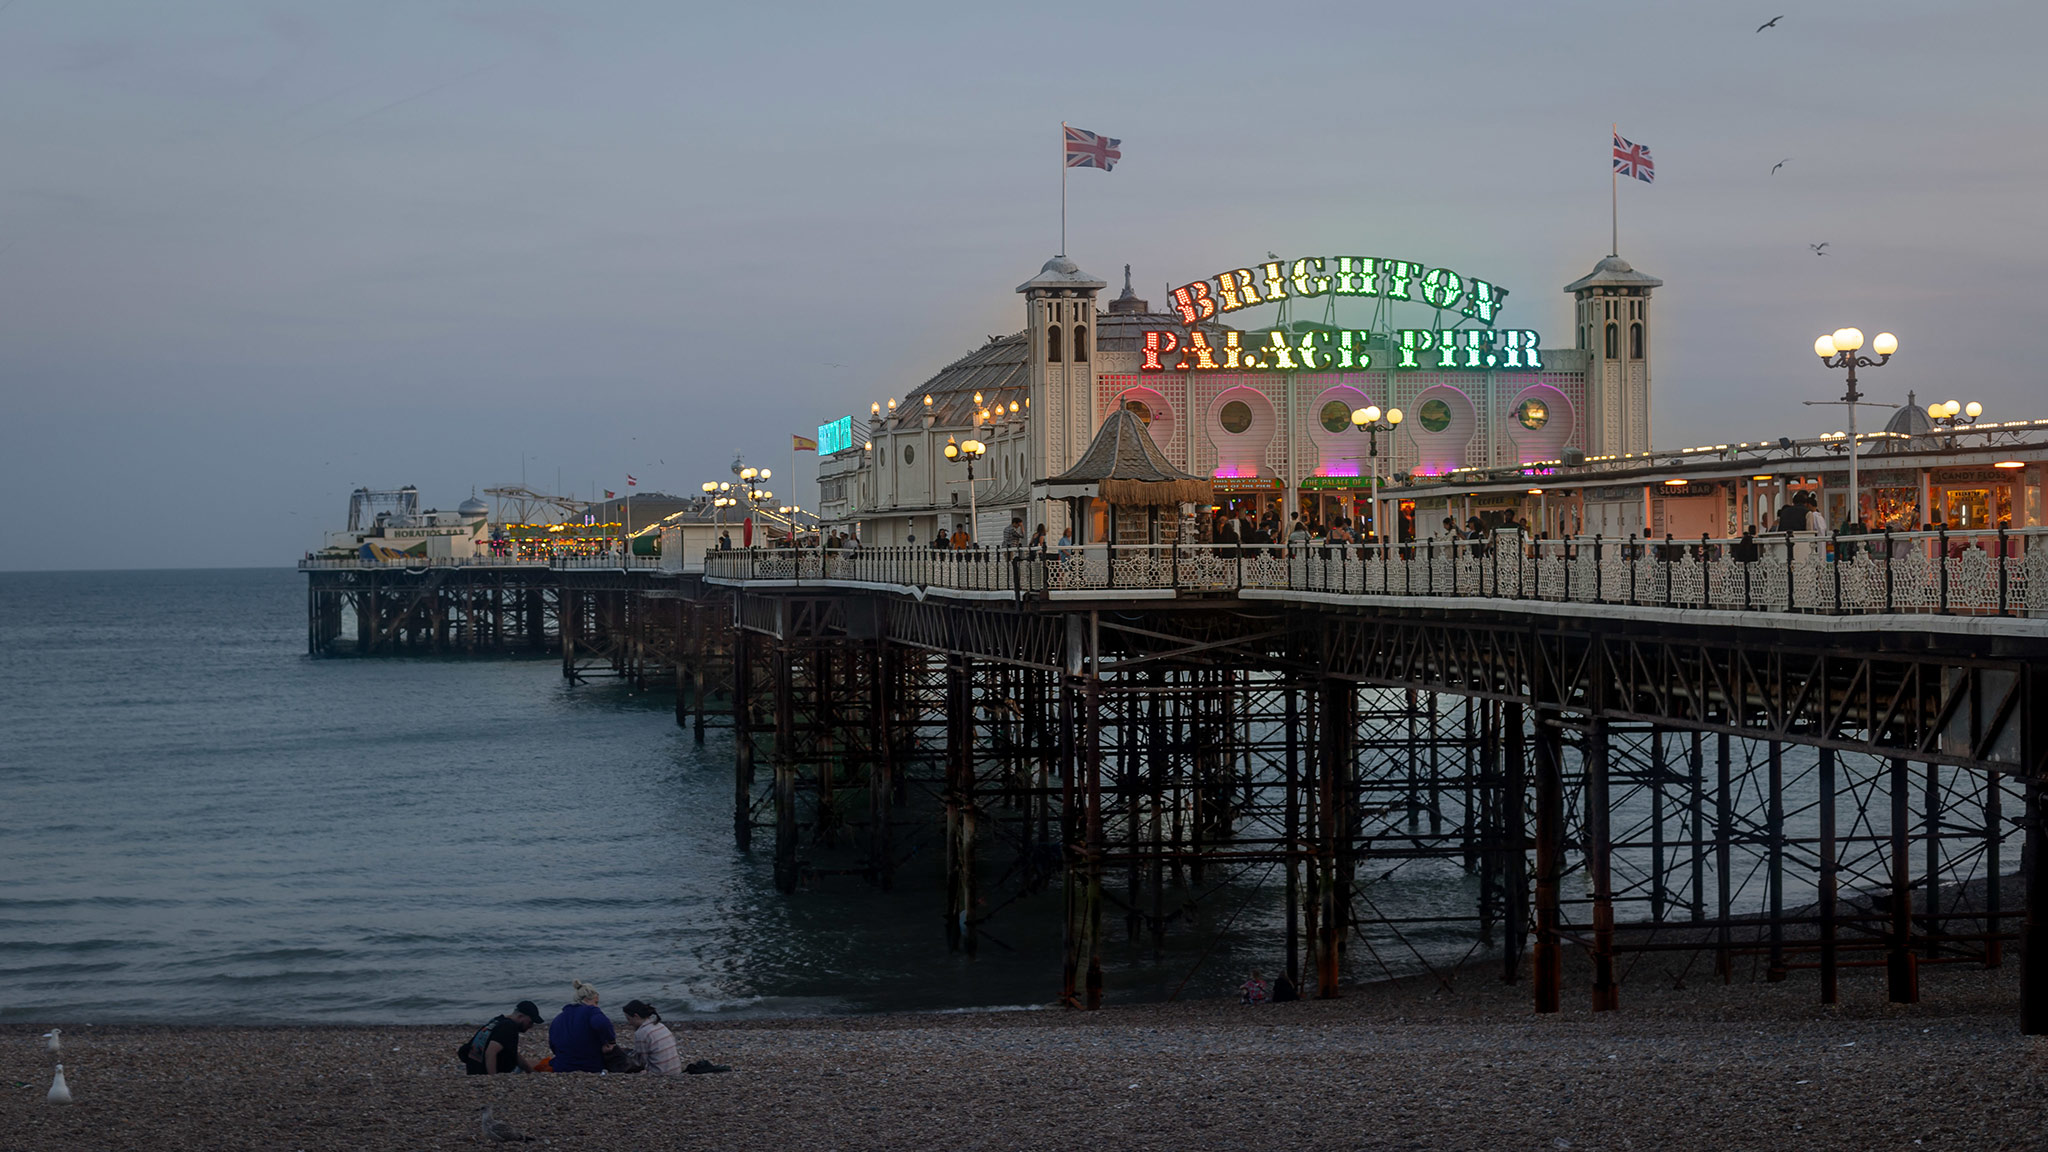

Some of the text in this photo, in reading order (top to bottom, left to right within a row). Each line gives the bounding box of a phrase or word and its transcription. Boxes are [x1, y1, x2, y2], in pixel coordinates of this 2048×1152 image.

[1168, 256, 1510, 326] BRIGHTON
[1141, 329, 1545, 373] PALACE PIER
[1942, 471, 2006, 480] CANDY FLOSS
[1352, 478, 1362, 486] OF
[1660, 485, 1710, 495] SLUSH BAR
